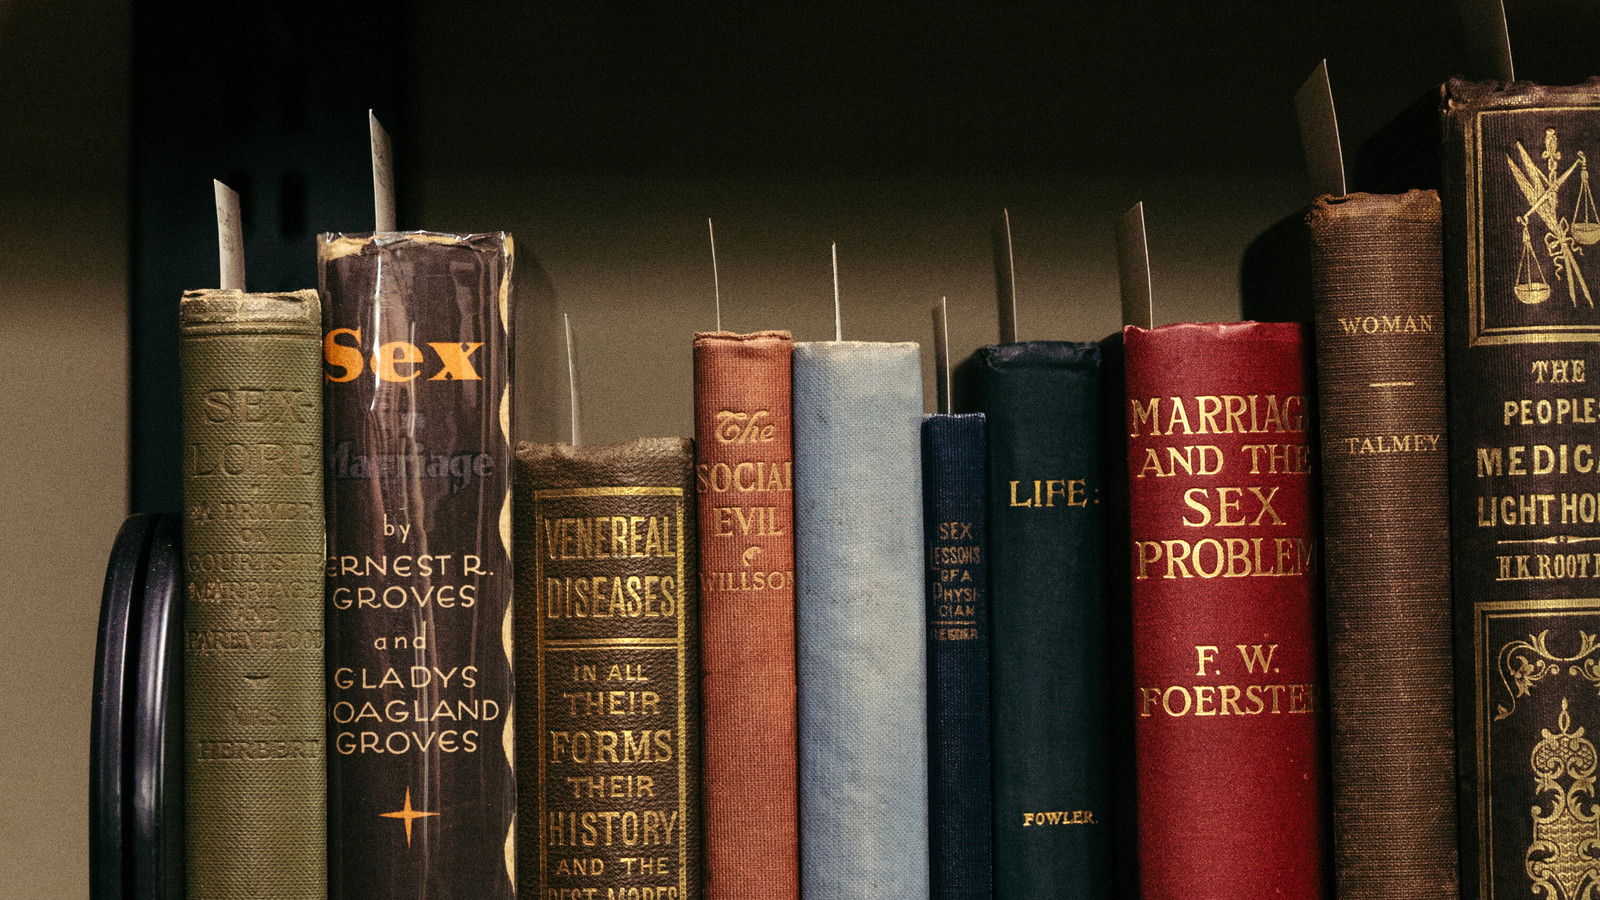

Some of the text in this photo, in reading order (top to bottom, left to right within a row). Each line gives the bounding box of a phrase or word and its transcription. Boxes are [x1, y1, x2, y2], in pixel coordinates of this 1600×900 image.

[1338, 314, 1433, 334] WOMAN
[324, 326, 484, 385] Sex
[1531, 360, 1586, 384] THE
[715, 410, 776, 443] The
[1345, 434, 1440, 454] TALMEY
[191, 442, 316, 477] LORE
[1137, 444, 1311, 477] AND THE
[1009, 479, 1099, 508] LIFE:
[1182, 486, 1287, 527] SEX
[713, 507, 783, 536] EVIL
[1478, 494, 1556, 527] LIGHT
[384, 513, 411, 543] by
[544, 516, 676, 559] VENEREAL
[940, 521, 973, 540] SEX
[327, 554, 495, 577] ERNEST R.
[960, 569, 973, 582] A
[333, 585, 476, 610] GROVES
[547, 575, 676, 618] DISEASES
[374, 620, 427, 650] and
[573, 663, 649, 681] IN ALL
[1195, 644, 1280, 676] F. W.
[334, 665, 479, 689] GLADYS
[328, 699, 500, 724] OAGLAND
[563, 690, 661, 716] THEIR
[336, 729, 480, 755] GROVES
[550, 729, 674, 763] FORMS
[567, 775, 655, 798] THEIR
[549, 810, 678, 846] HISTORY
[556, 857, 670, 876] AND THE
